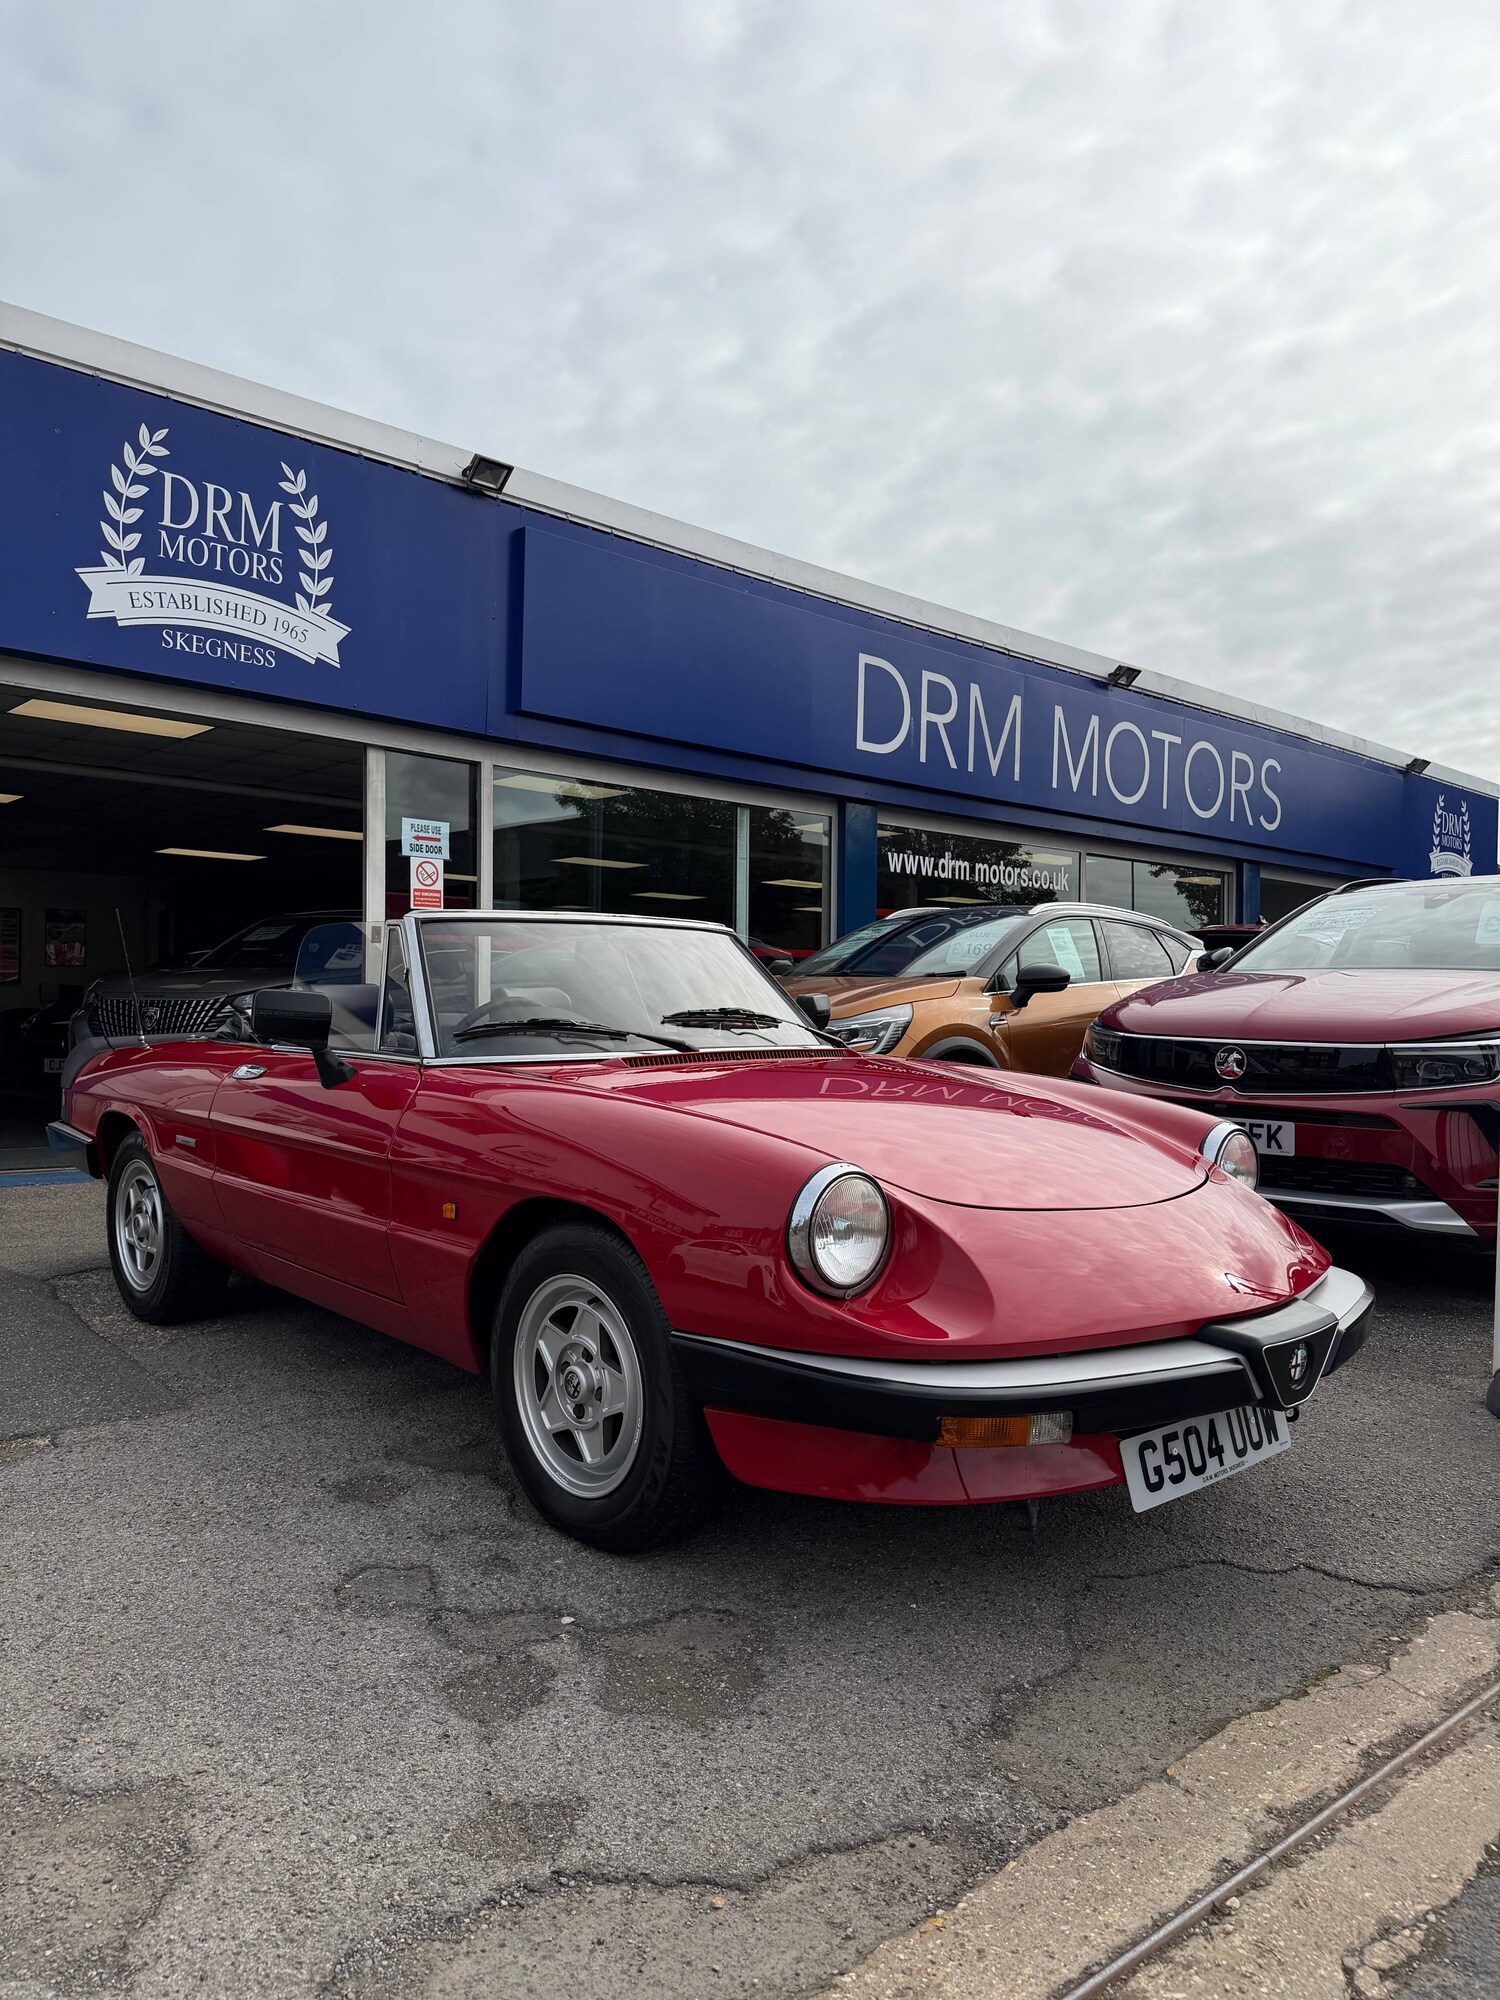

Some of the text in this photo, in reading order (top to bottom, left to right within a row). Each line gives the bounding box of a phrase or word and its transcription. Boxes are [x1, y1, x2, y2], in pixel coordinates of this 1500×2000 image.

[158, 470, 284, 554] DRM
[158, 530, 283, 585] MOTORS
[128, 591, 309, 643] ESTABLISHED 1965
[161, 628, 276, 668] SKEGNESS
[856, 652, 1282, 832] DRM MOTORS
[410, 823, 442, 835] PLEASE USE
[1441, 834, 1463, 850] MOTORS
[1442, 811, 1463, 837] DRM
[409, 842, 443, 855] SIDE DOOR
[1138, 1418, 1224, 1493] G504
